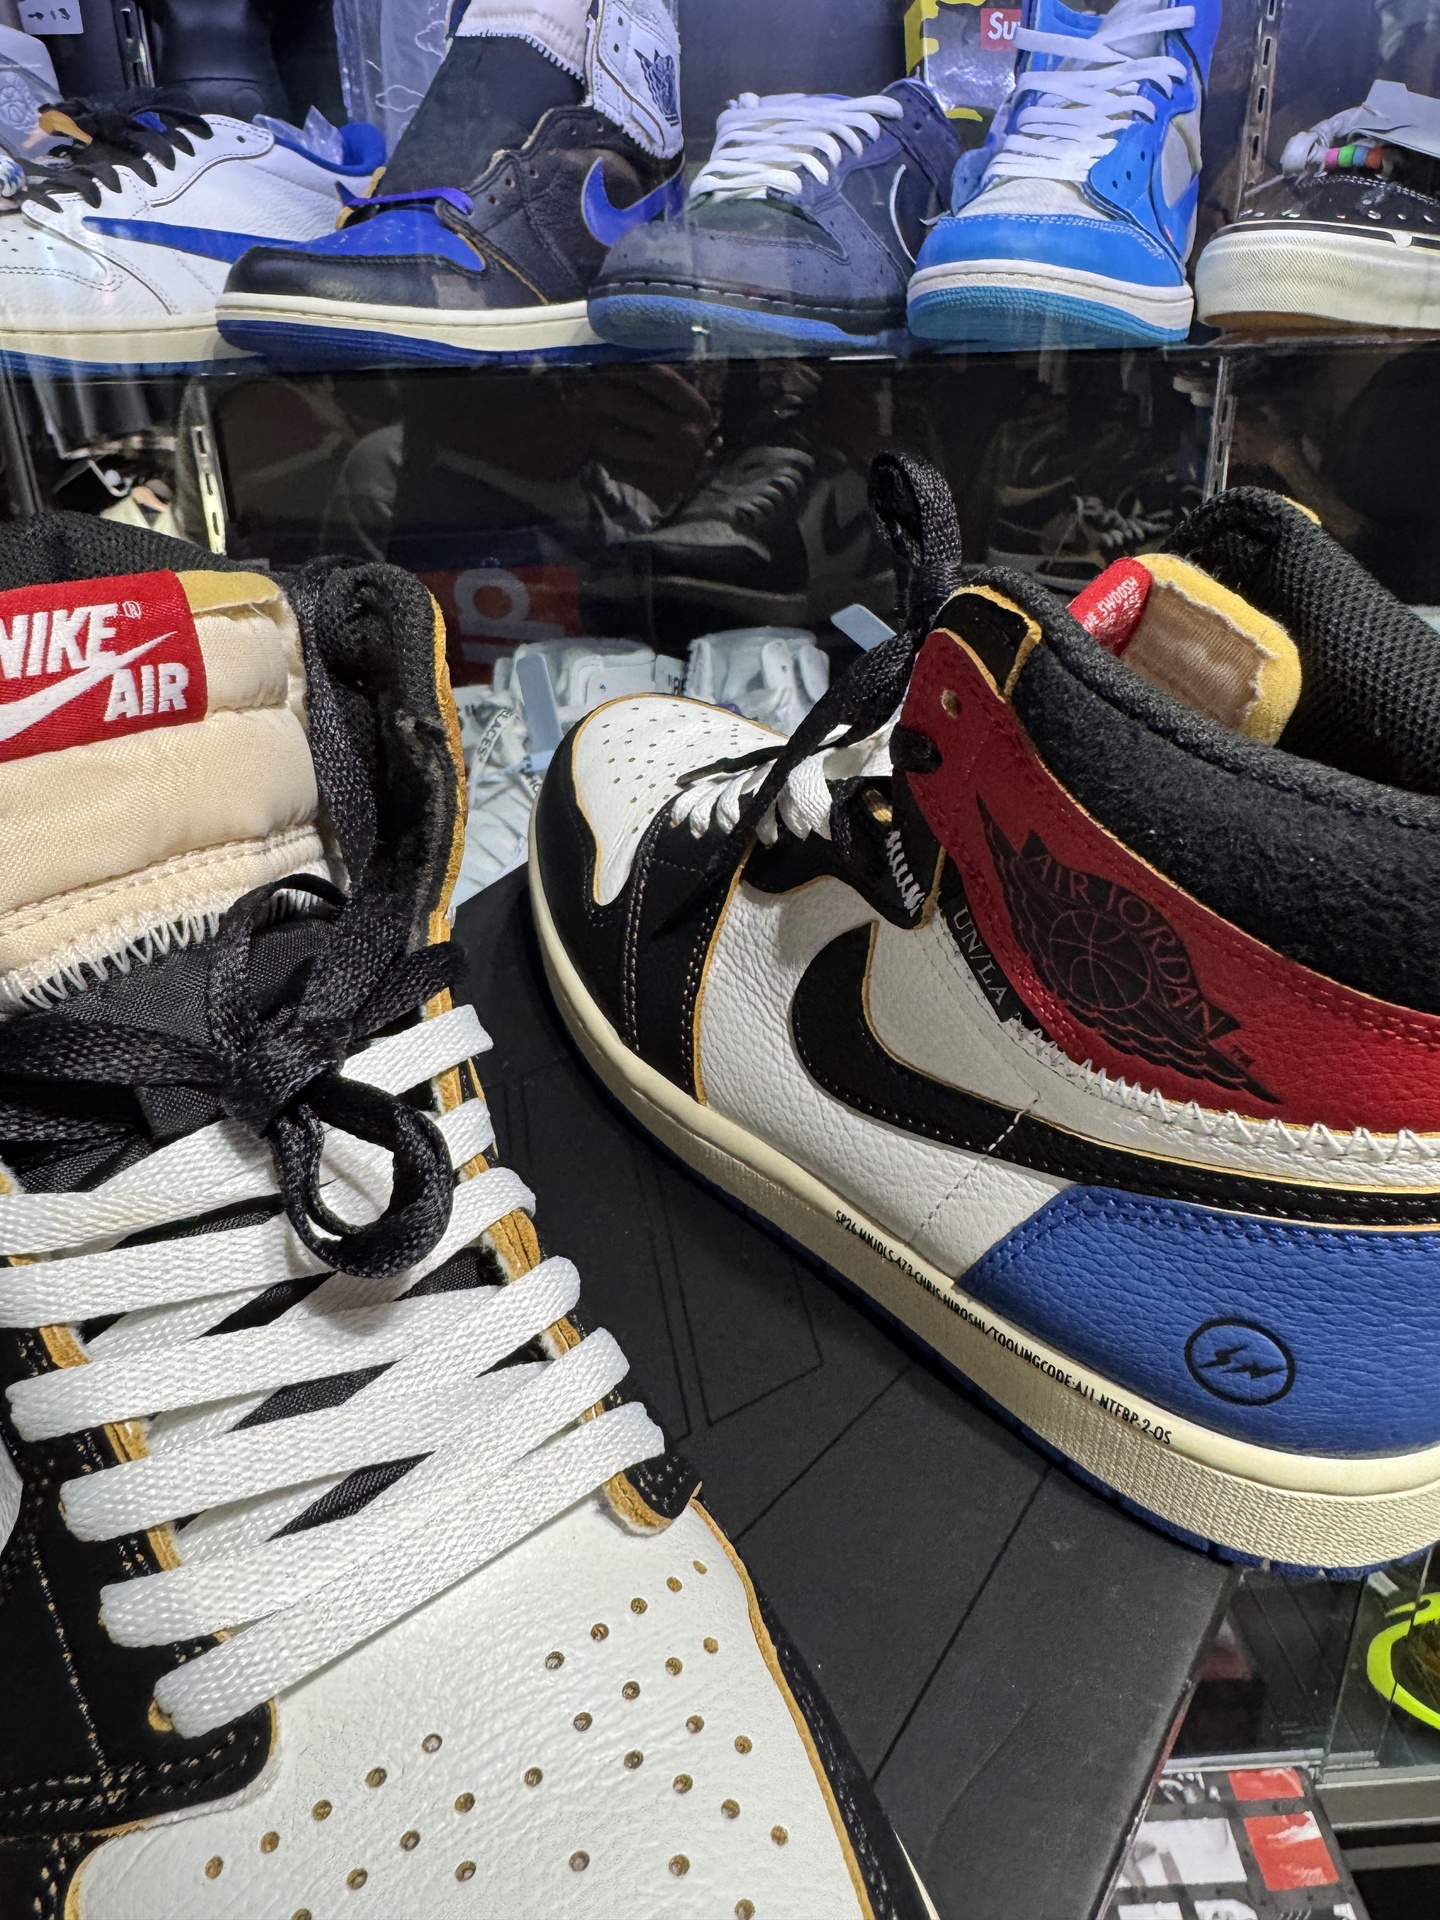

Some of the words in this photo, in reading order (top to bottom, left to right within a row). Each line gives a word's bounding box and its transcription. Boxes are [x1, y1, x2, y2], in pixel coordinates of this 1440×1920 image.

[988, 11, 1020, 40] Su
[1097, 576, 1139, 617] SWOOSH
[103, 662, 189, 722] AIR
[1024, 853, 1091, 904] AIR
[1106, 883, 1226, 1041] JORDAN
